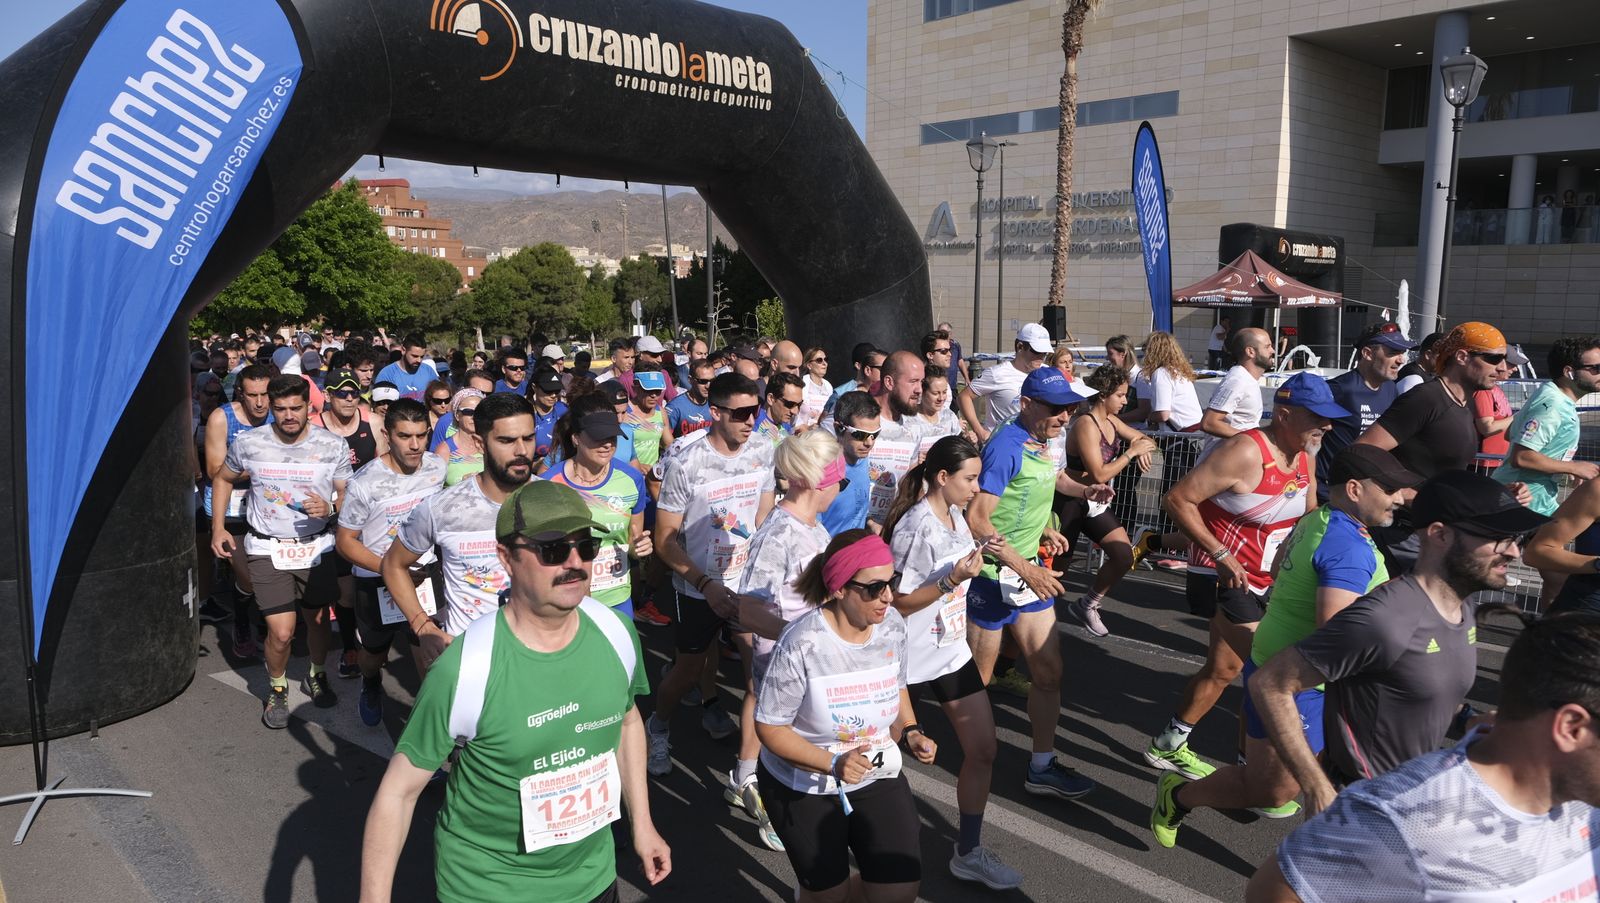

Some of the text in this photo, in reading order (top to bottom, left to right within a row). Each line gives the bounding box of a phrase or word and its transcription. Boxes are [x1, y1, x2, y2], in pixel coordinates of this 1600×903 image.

[615, 72, 772, 112] cronometraje deportivo
[168, 76, 293, 267] centrohogarsanchez.es
[277, 546, 316, 559] 1037
[533, 756, 549, 771] El
[551, 746, 586, 766] Ejido
[537, 780, 609, 822] 1211
